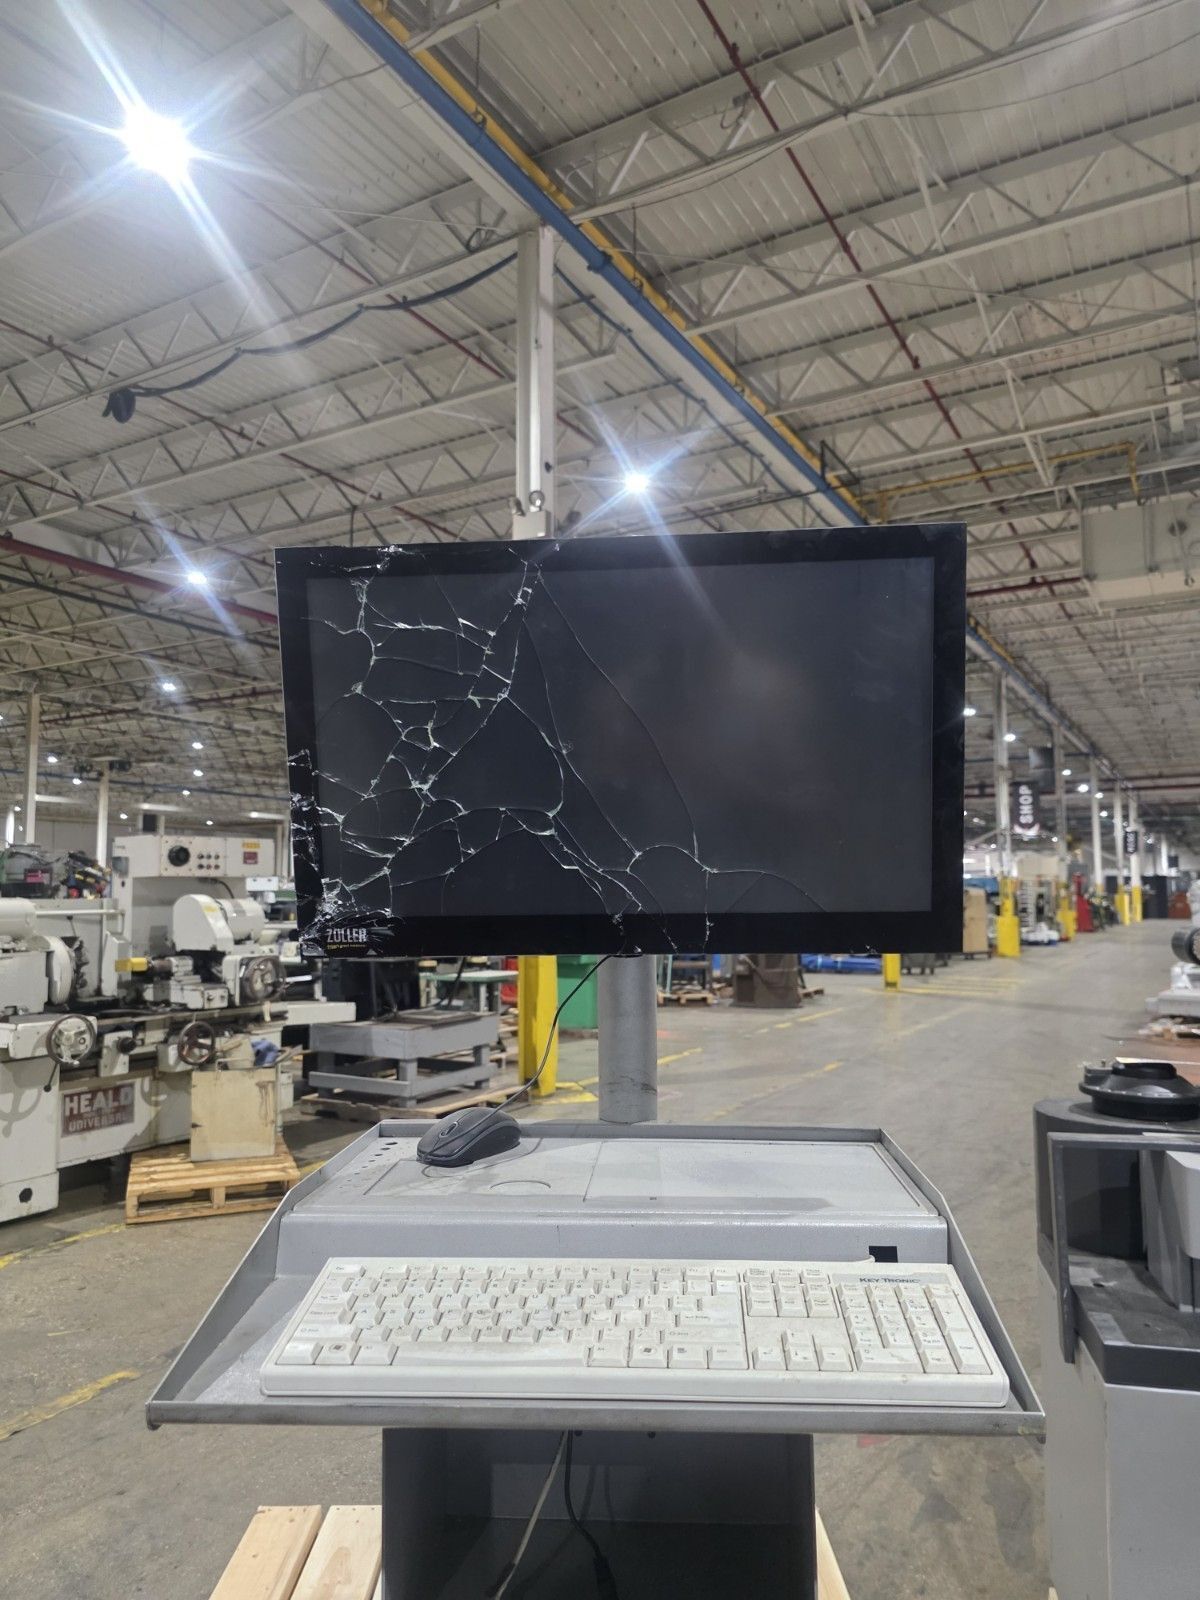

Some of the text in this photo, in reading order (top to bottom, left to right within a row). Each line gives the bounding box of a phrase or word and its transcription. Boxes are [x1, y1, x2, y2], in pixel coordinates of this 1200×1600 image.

[1018, 784, 1034, 824] SHOP
[326, 928, 367, 942] ZOLLER
[65, 1086, 132, 1117] HEALD
